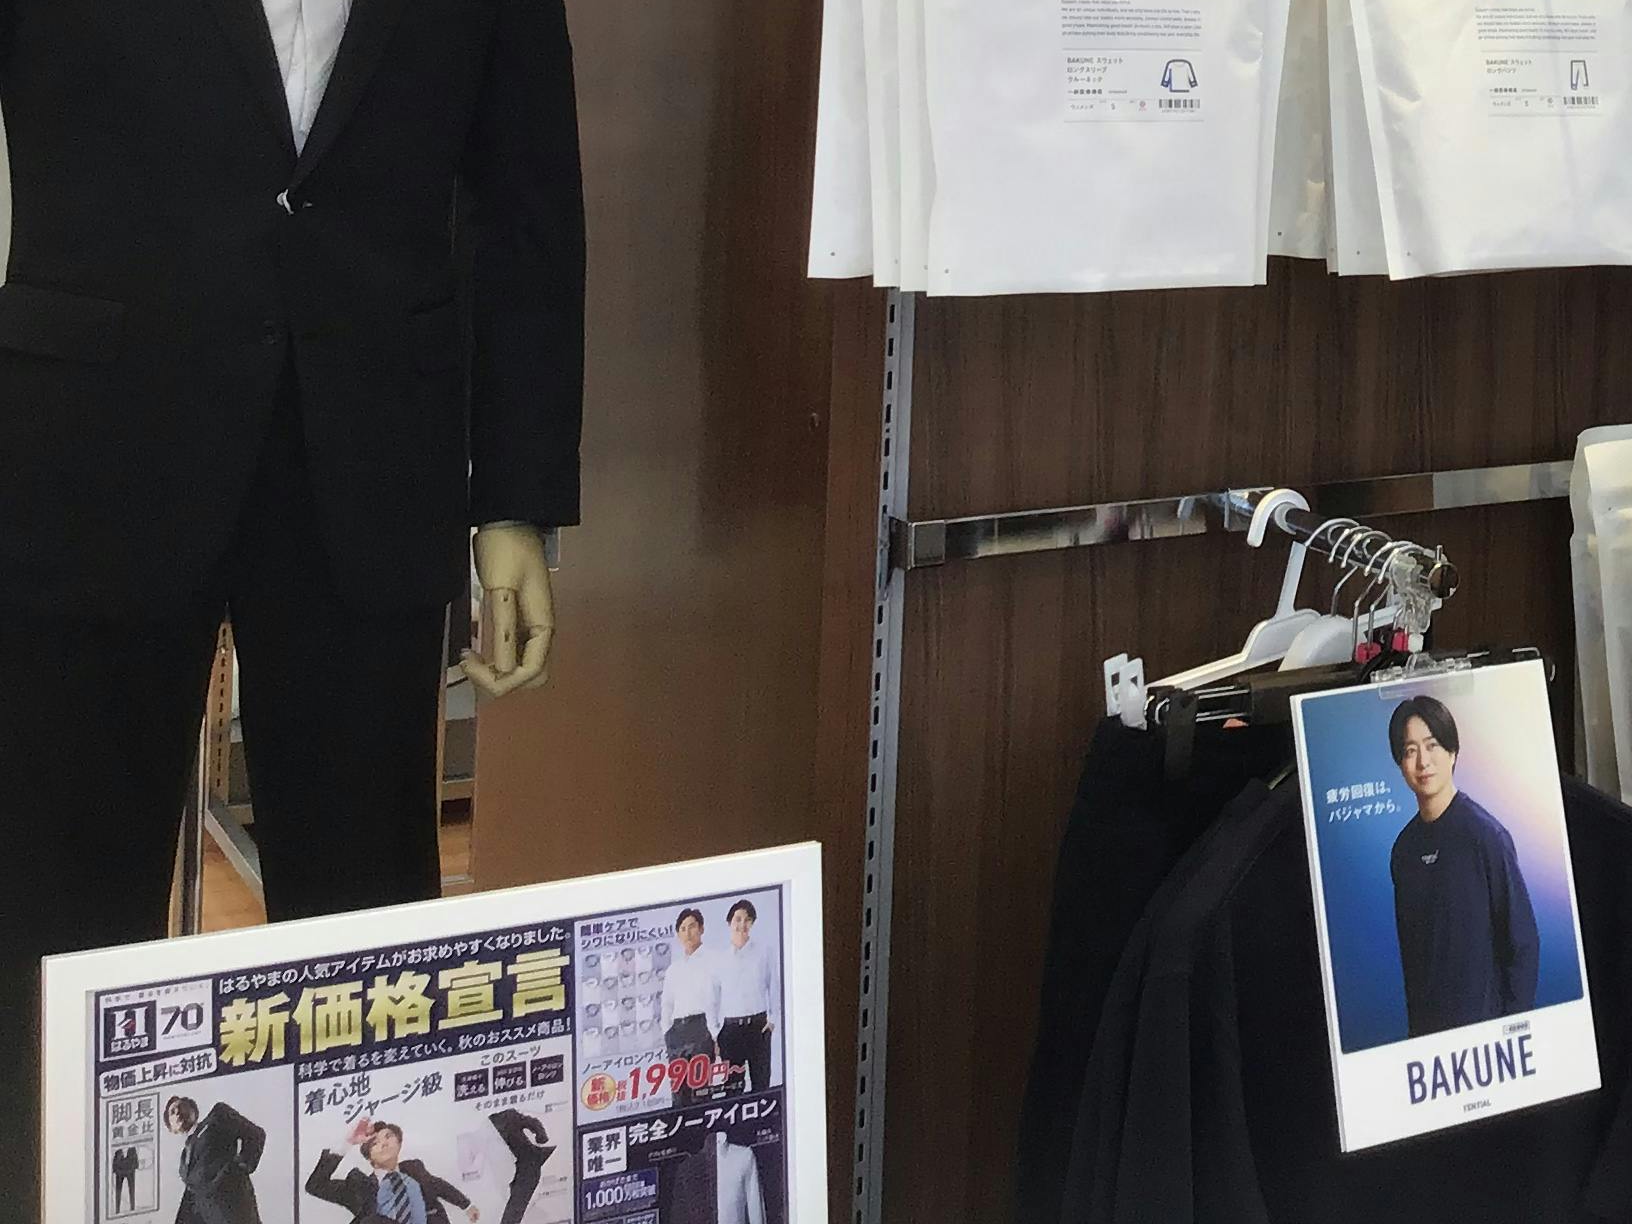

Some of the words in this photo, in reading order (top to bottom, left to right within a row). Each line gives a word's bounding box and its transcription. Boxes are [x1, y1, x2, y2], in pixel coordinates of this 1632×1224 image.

[1326, 780, 1391, 804] 疲労回復は、
[1329, 799, 1402, 823] パジャマから。
[580, 917, 638, 937] 簡単ケアで
[580, 925, 674, 950] シワになりにくい!
[219, 926, 571, 995] はるやまの人気アイテムがお求めやすくなりました。
[218, 947, 570, 1067] 新価格宣言
[111, 1036, 149, 1053] はるやま
[480, 1045, 541, 1066] このスーツ
[104, 1053, 212, 1092] 物価上昇に対抗
[1407, 1034, 1536, 1105] BAKUNE
[304, 1072, 371, 1116] 着心地
[456, 1083, 485, 1097] 洗える
[494, 1076, 524, 1090] 伸びる
[344, 1071, 442, 1124] ジャージ級
[475, 1090, 545, 1111] そのまま着るだけ
[1463, 1100, 1492, 1112] TENTIAL
[112, 1098, 153, 1125] 脚長
[628, 1098, 777, 1146] 完全ノーアイロン
[112, 1121, 154, 1139] 黄金比
[587, 1132, 621, 1155] 業界
[587, 1155, 622, 1172] 唯一
